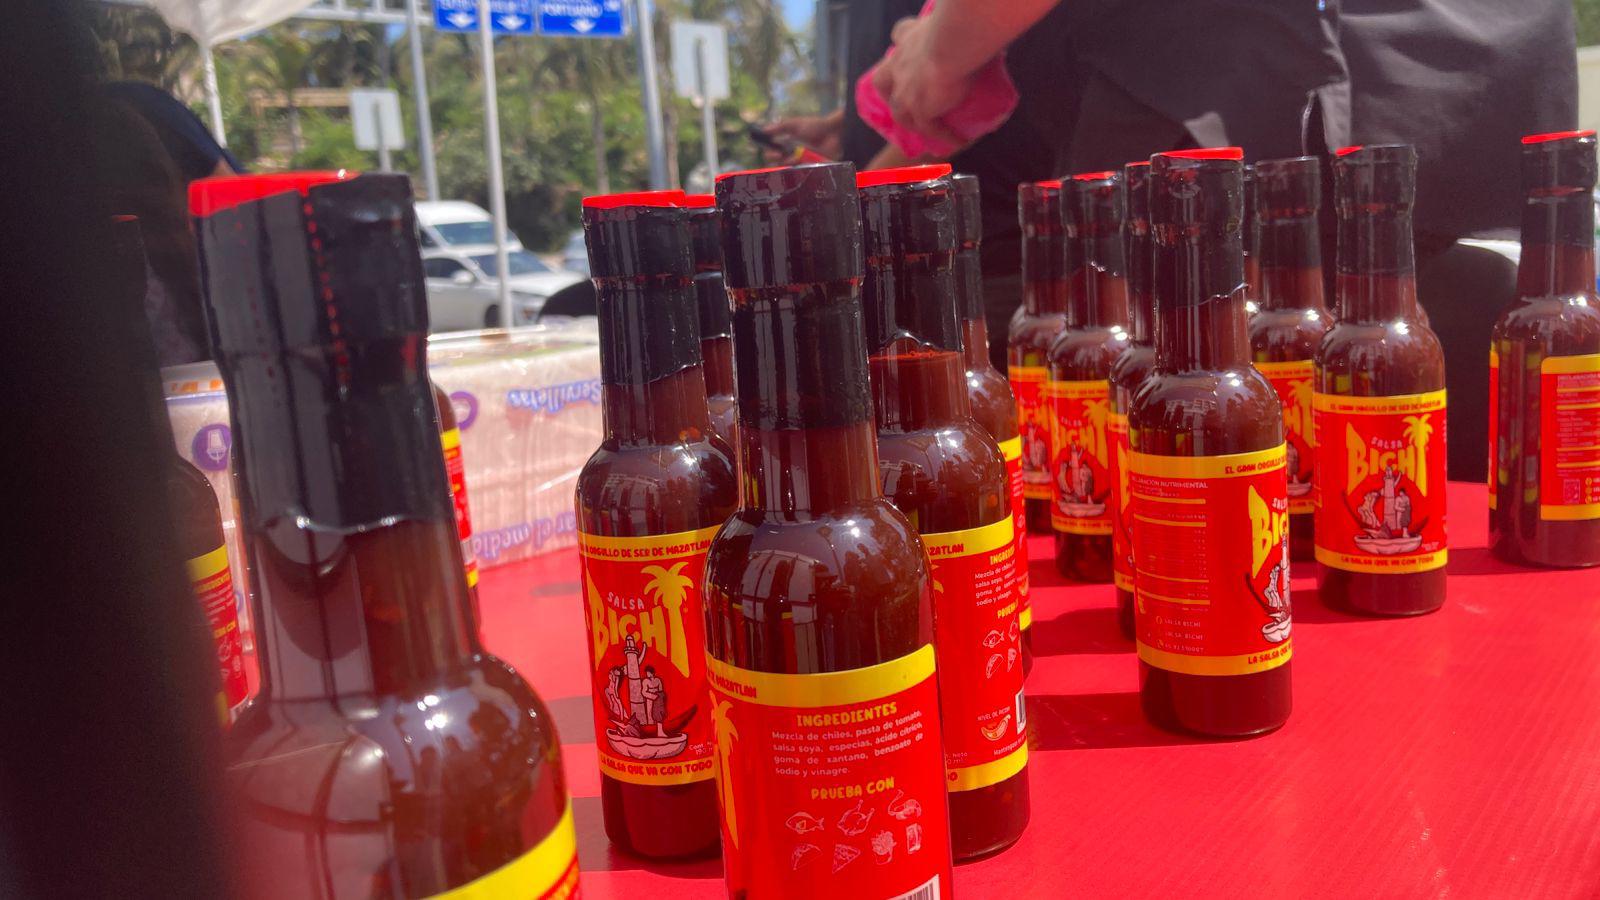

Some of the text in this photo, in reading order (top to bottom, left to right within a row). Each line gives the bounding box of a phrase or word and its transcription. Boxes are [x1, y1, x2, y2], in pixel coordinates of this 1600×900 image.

[507, 379, 602, 414] Servilletas
[1371, 436, 1402, 449] SALSA
[1345, 414, 1432, 497] BICHI
[1225, 466, 1234, 474] EL
[1237, 464, 1256, 473] GRAN
[589, 546, 619, 558] ORGULLO
[621, 548, 632, 558] DE
[634, 548, 650, 558] SER
[652, 547, 664, 557] DE
[975, 570, 994, 580] Mezcla
[975, 580, 990, 588] salsa
[607, 591, 645, 611] SALSA
[585, 562, 694, 679] BICHI
[1248, 656, 1257, 664] LA
[1260, 651, 1279, 663] SALSA
[796, 701, 897, 727] INGREDIENTES
[772, 731, 803, 741] Mezcla
[807, 731, 819, 741] de
[856, 724, 881, 738] pasta
[882, 720, 894, 731] de
[773, 743, 795, 753] salsa
[774, 755, 800, 765] goma
[807, 754, 819, 765] de
[874, 738, 912, 757] benzoato
[915, 732, 924, 742] de
[607, 758, 626, 773] SALSA
[628, 764, 645, 776] QUE
[646, 766, 658, 776] VA
[660, 765, 682, 776] CON
[684, 759, 713, 773] TODO
[775, 766, 800, 776] sodio
[803, 768, 808, 778] y
[811, 776, 895, 800] PRUEBA CON
